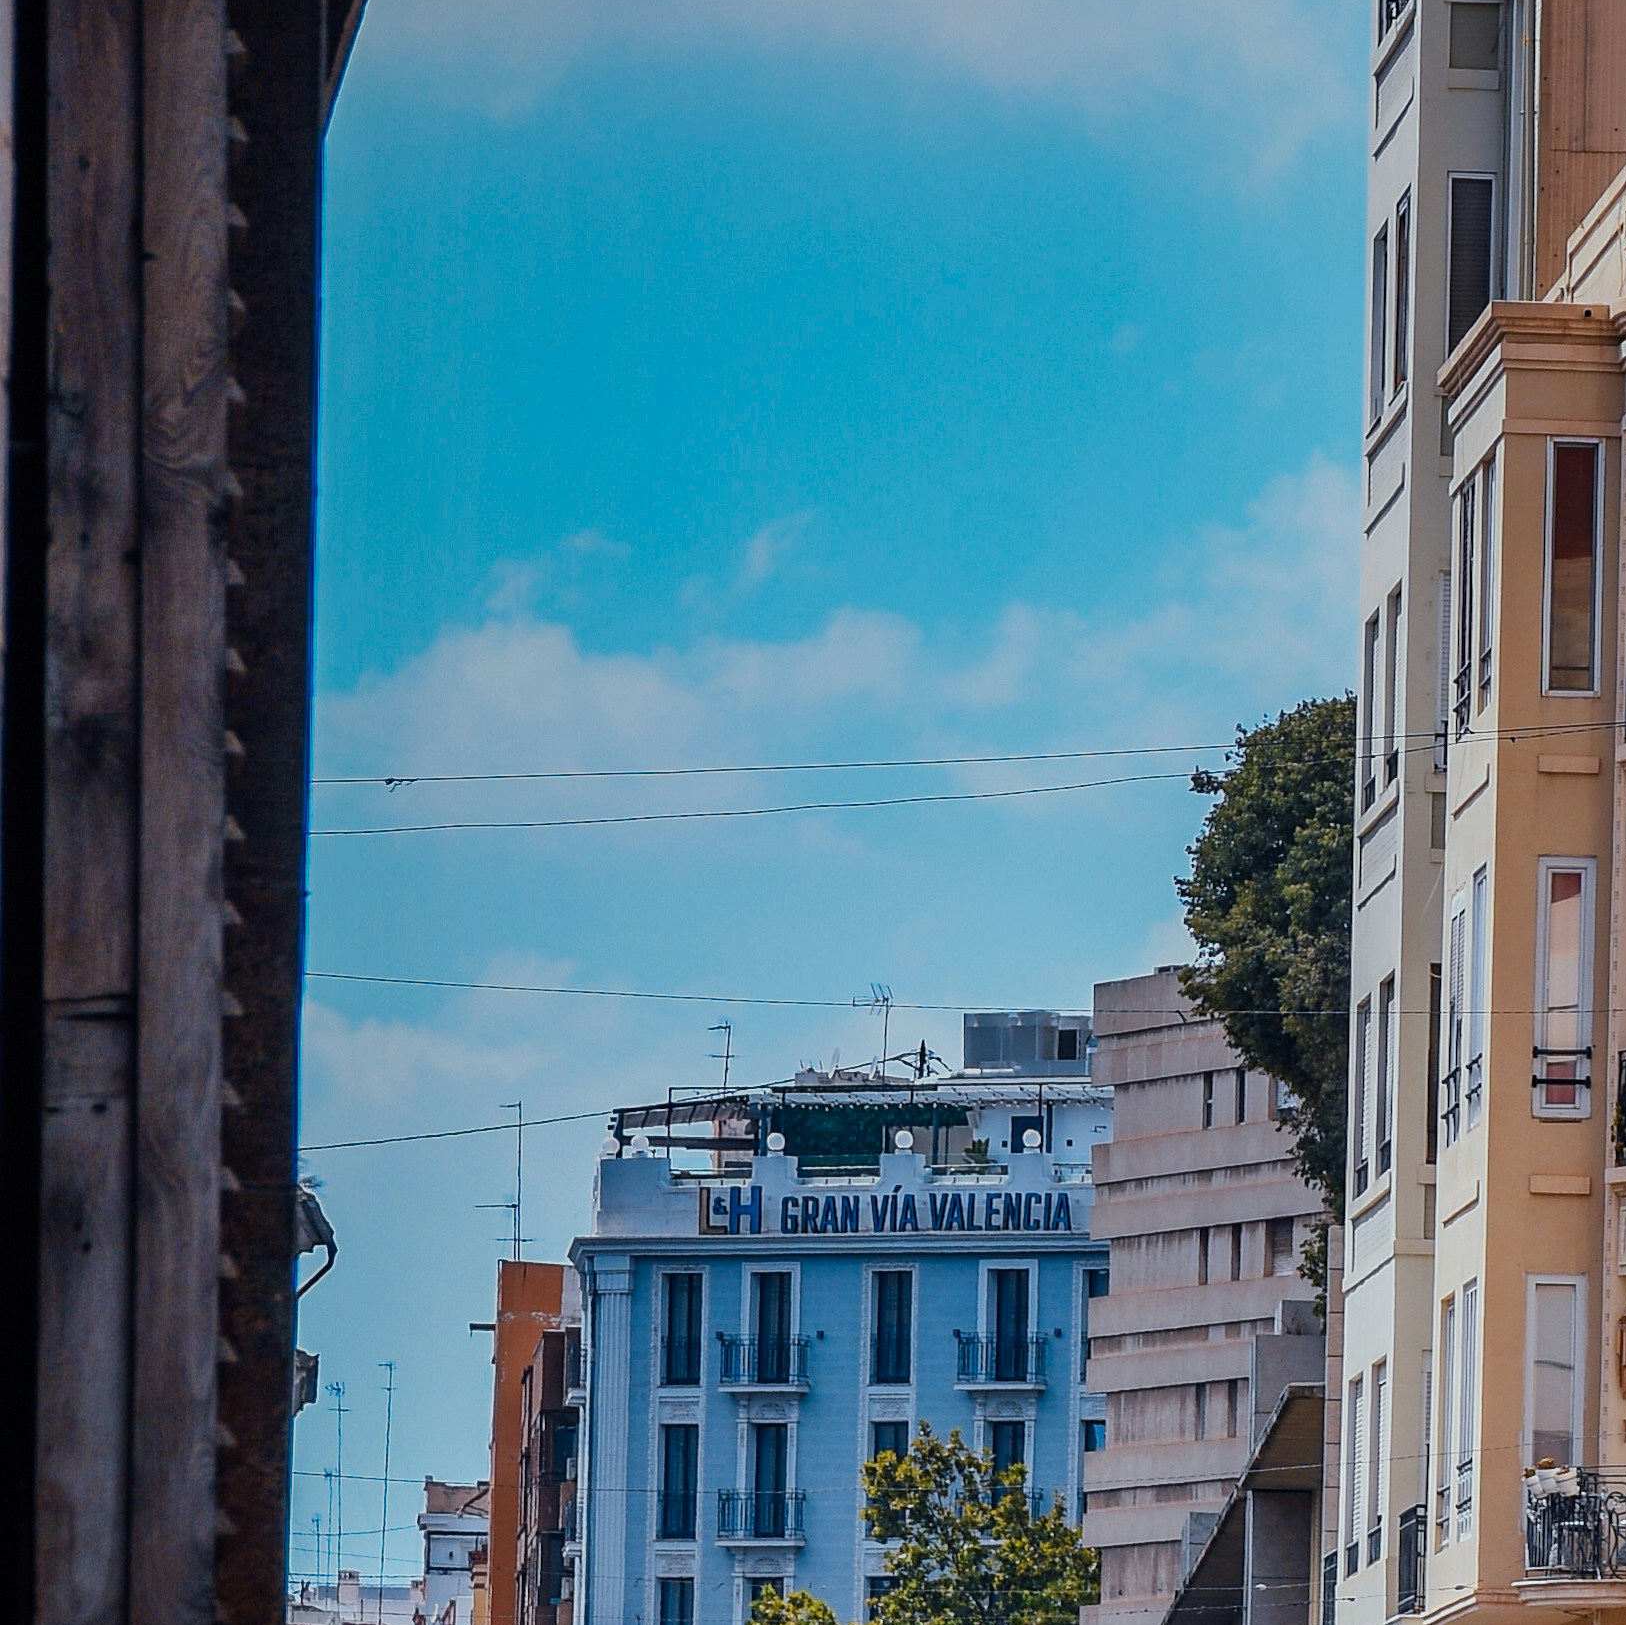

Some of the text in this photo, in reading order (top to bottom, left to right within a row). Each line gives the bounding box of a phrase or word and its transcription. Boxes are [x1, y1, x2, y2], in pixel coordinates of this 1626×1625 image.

[700, 1184, 1073, 1235] L&H GRAN VÍA VALENCIA
